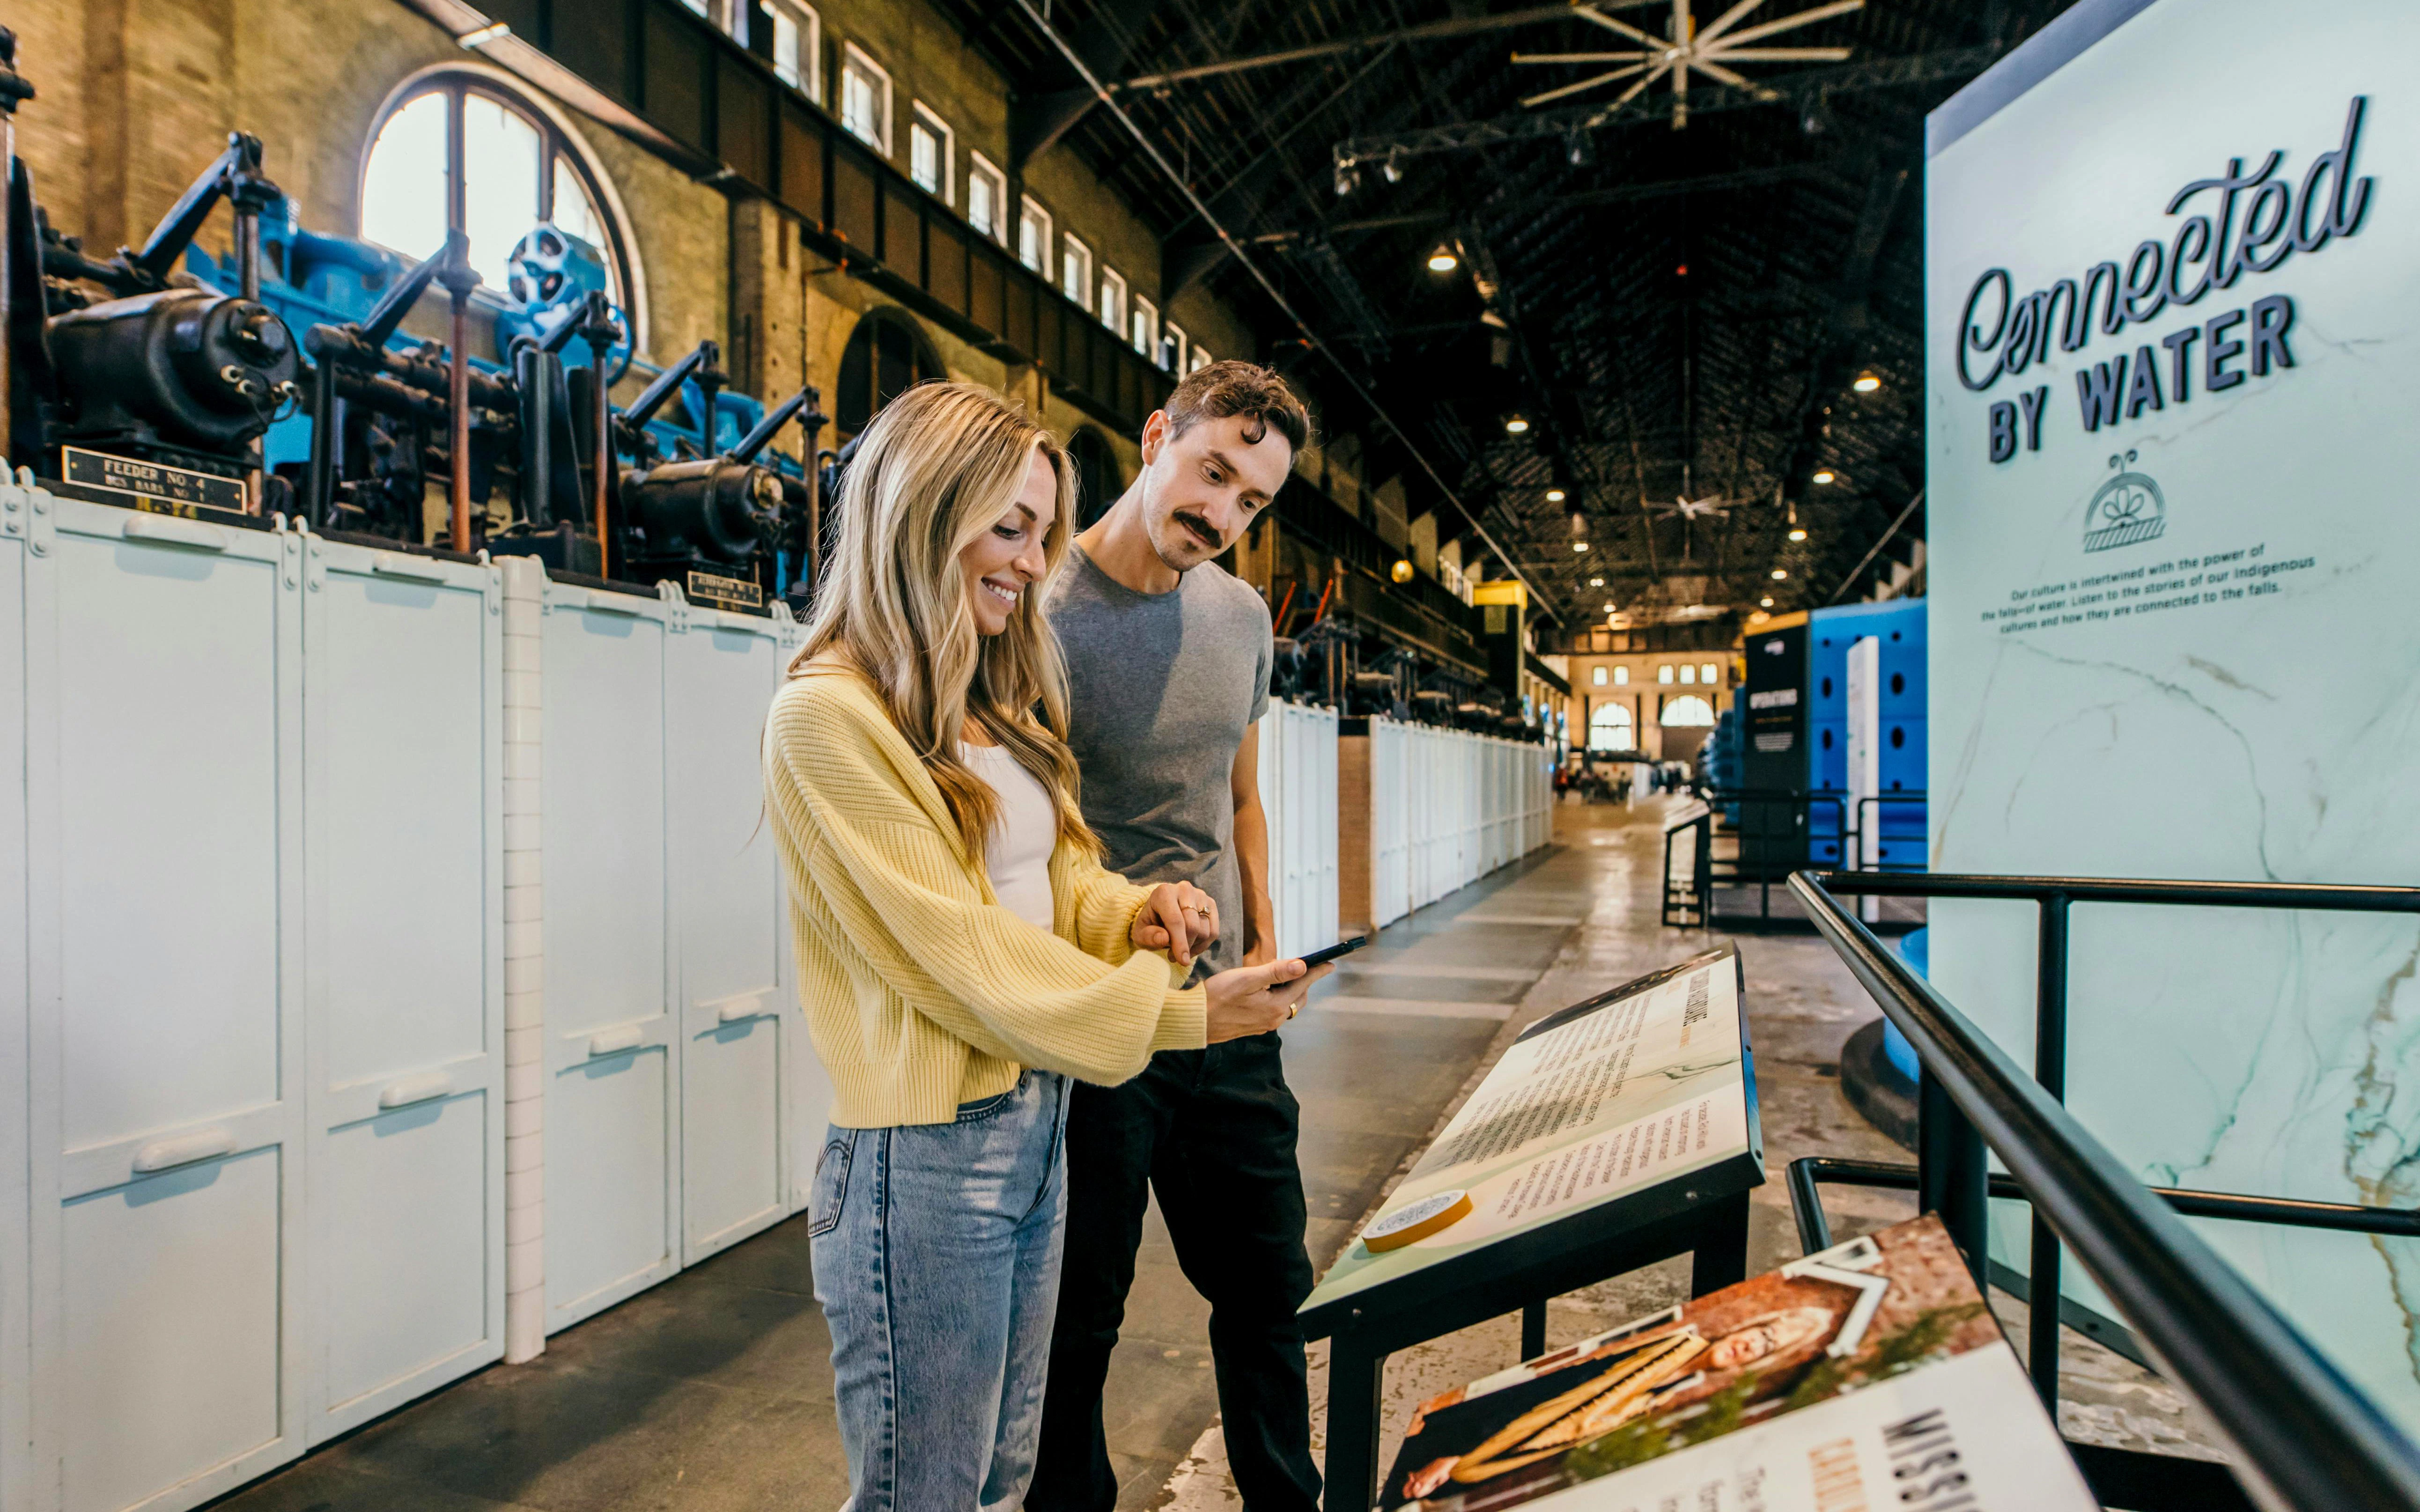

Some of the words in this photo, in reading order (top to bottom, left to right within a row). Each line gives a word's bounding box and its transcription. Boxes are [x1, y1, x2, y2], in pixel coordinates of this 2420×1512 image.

[1956, 95, 2373, 390] Connected
[1989, 384, 2049, 464] BY
[2076, 294, 2297, 433] WATER
[103, 458, 158, 481] FEEDER
[196, 478, 205, 491] 4
[1981, 610, 1996, 622] the
[2072, 591, 2103, 607] Listen
[2107, 589, 2118, 600] to
[2122, 585, 2141, 597] the
[2145, 579, 2186, 594] stories
[2190, 573, 2203, 587] of
[2207, 571, 2230, 584] our
[2235, 556, 2316, 579] Indigenous
[2012, 589, 2028, 601] Our
[2031, 581, 2066, 597] culture
[2070, 580, 2078, 590] is
[2081, 566, 2145, 588] intertwined
[2149, 561, 2174, 575] with
[2178, 558, 2199, 570] the
[2203, 549, 2245, 567] power
[2250, 542, 2265, 558] of
[1999, 619, 2037, 634] cultures
[2041, 616, 2059, 628] and
[2062, 613, 2083, 624] how
[2087, 609, 2110, 624] they
[2114, 605, 2132, 616] are
[2135, 593, 2199, 614] connected
[2203, 591, 2217, 603] to
[2221, 587, 2244, 601] the
[2248, 581, 2282, 596] falls.
[1881, 1406, 1985, 1512] MISSI
